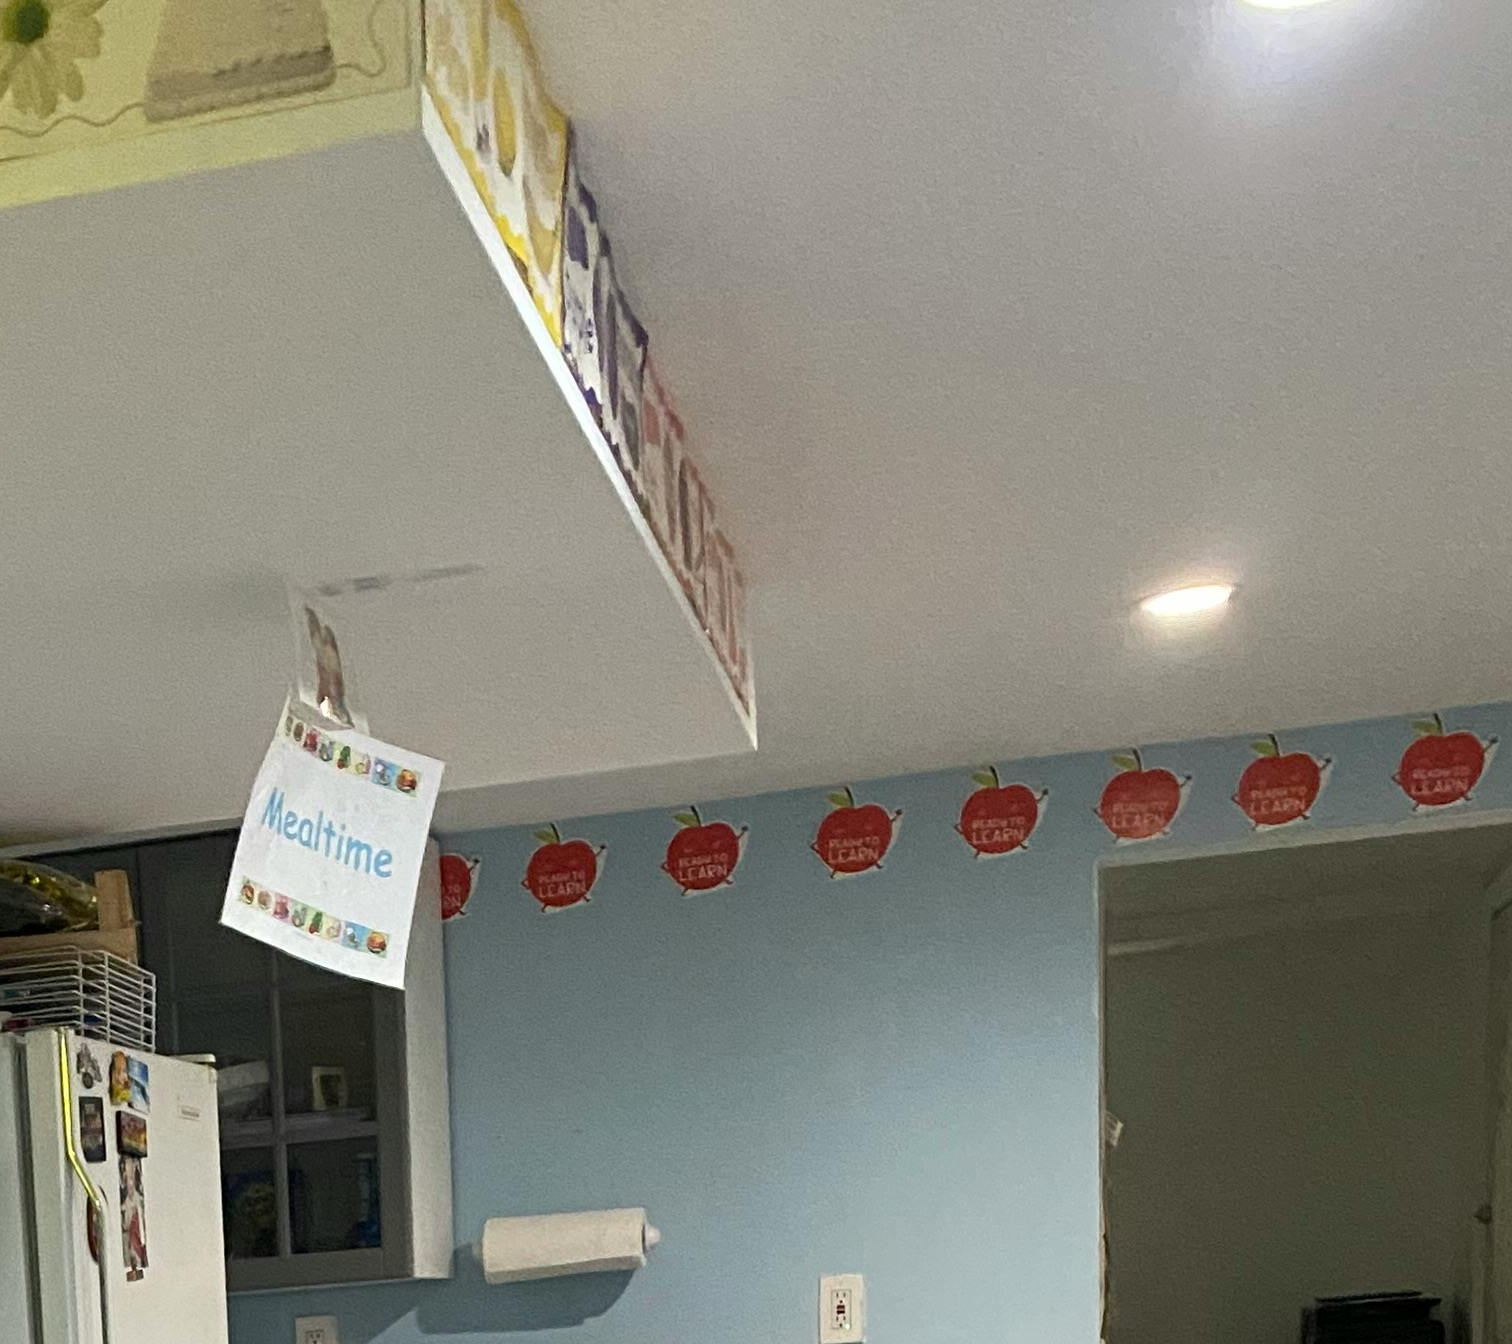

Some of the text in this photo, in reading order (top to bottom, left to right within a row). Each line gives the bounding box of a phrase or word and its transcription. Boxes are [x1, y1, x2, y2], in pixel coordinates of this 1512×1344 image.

[261, 786, 393, 878] Mealtime
[972, 828, 1025, 844] LEARN
[829, 847, 879, 864] LEARN
[679, 864, 728, 882] LEARN
[539, 882, 587, 899] LEARN
